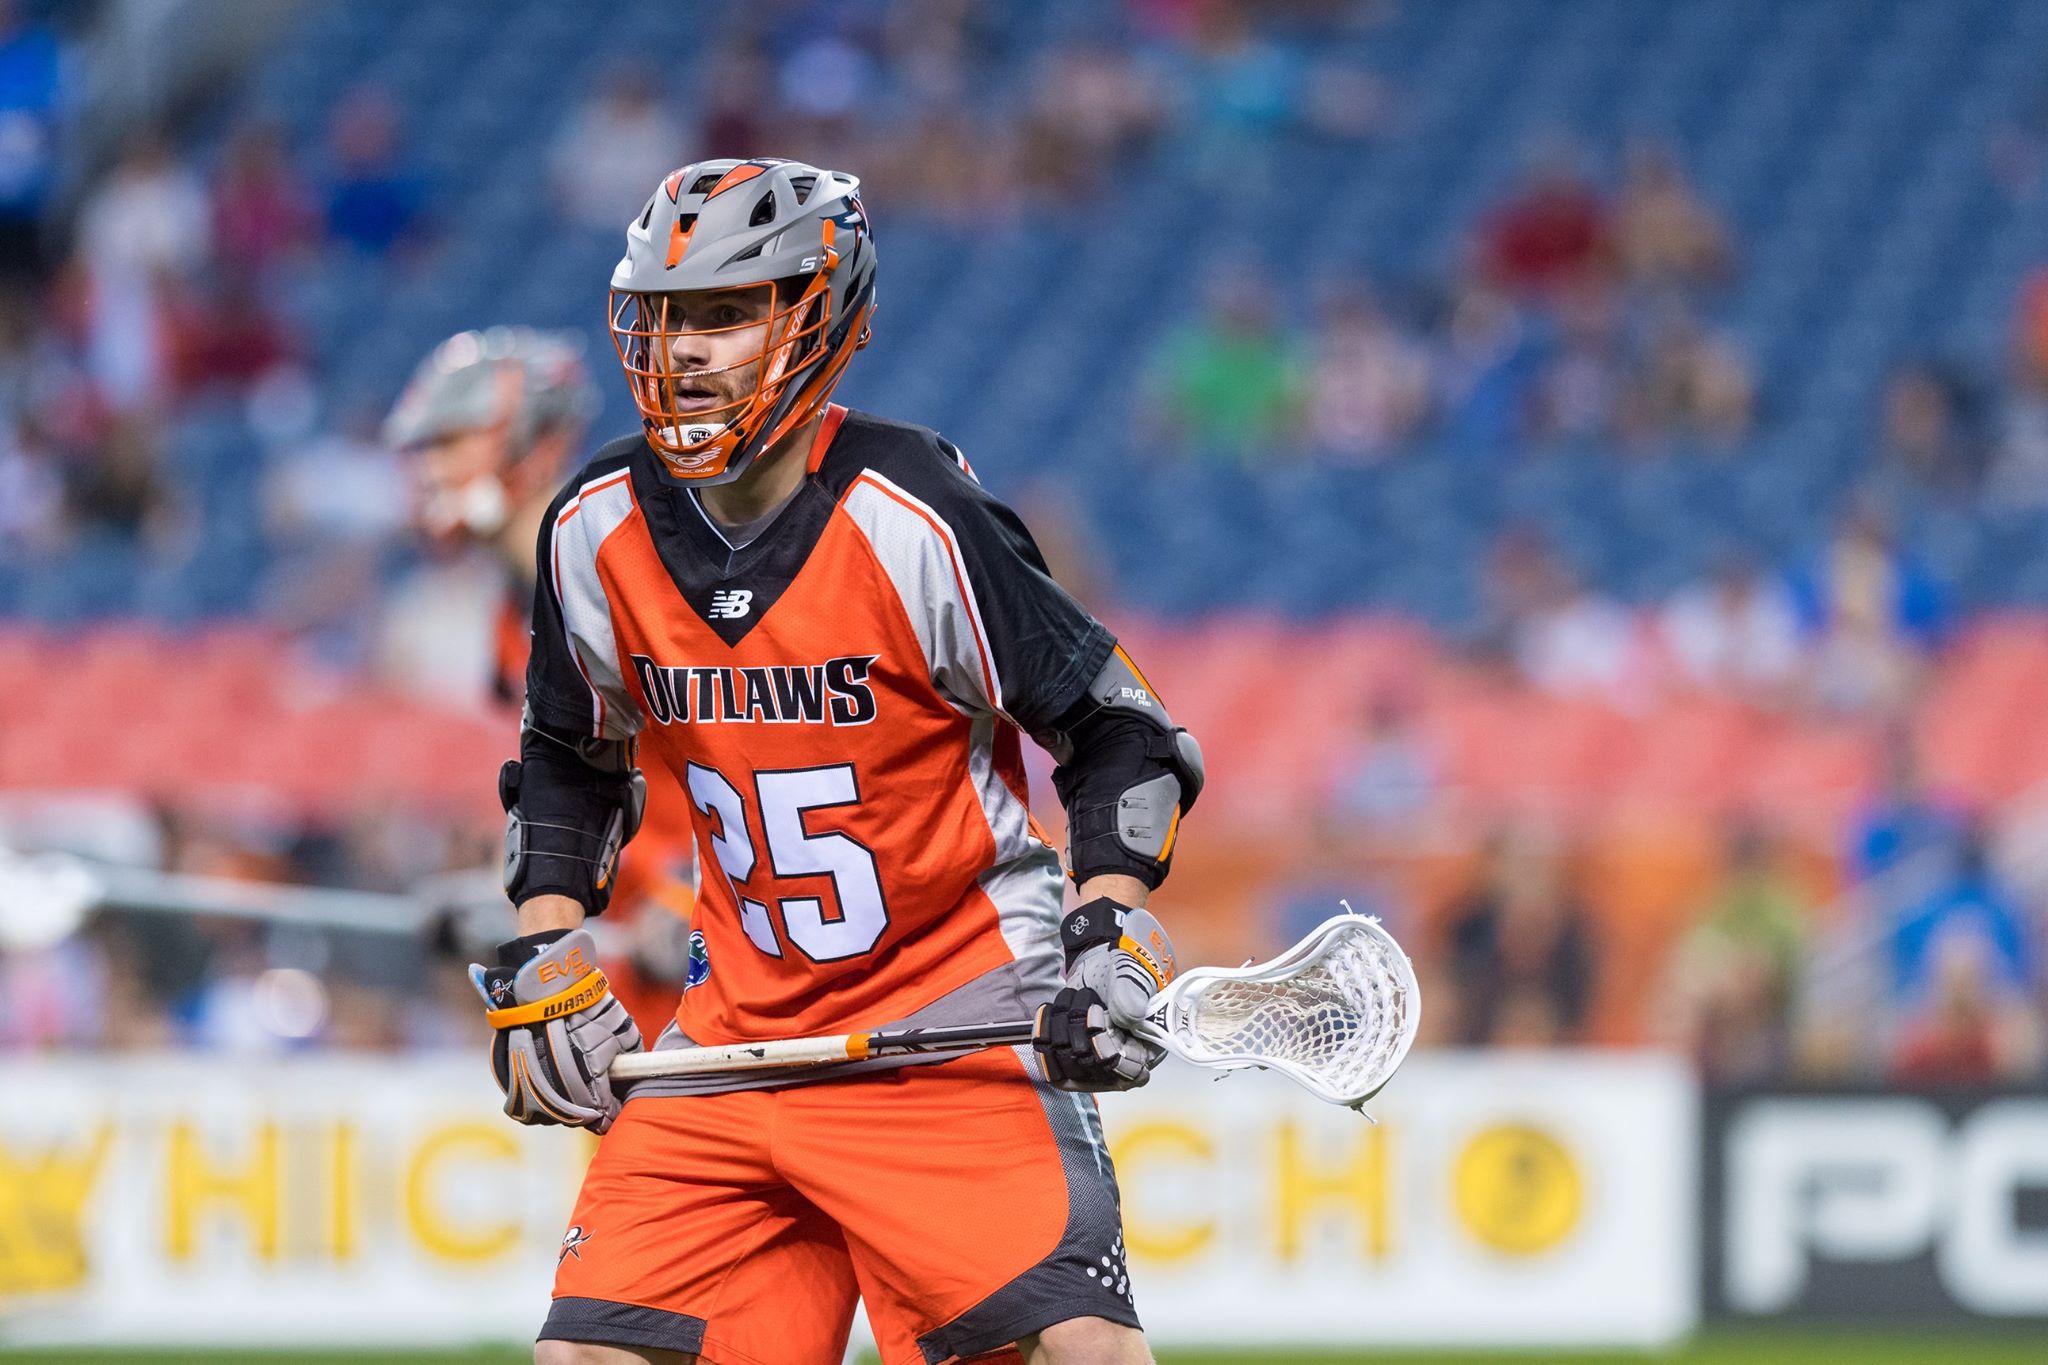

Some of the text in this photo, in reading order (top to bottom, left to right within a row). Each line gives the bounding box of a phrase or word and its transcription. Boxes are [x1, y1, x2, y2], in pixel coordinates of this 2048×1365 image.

[629, 653, 882, 727] OUTLAWS
[1121, 687, 1146, 701] EVO
[686, 759, 892, 965] 25
[538, 946, 583, 985] EVO
[543, 975, 608, 1019] WARRIOR
